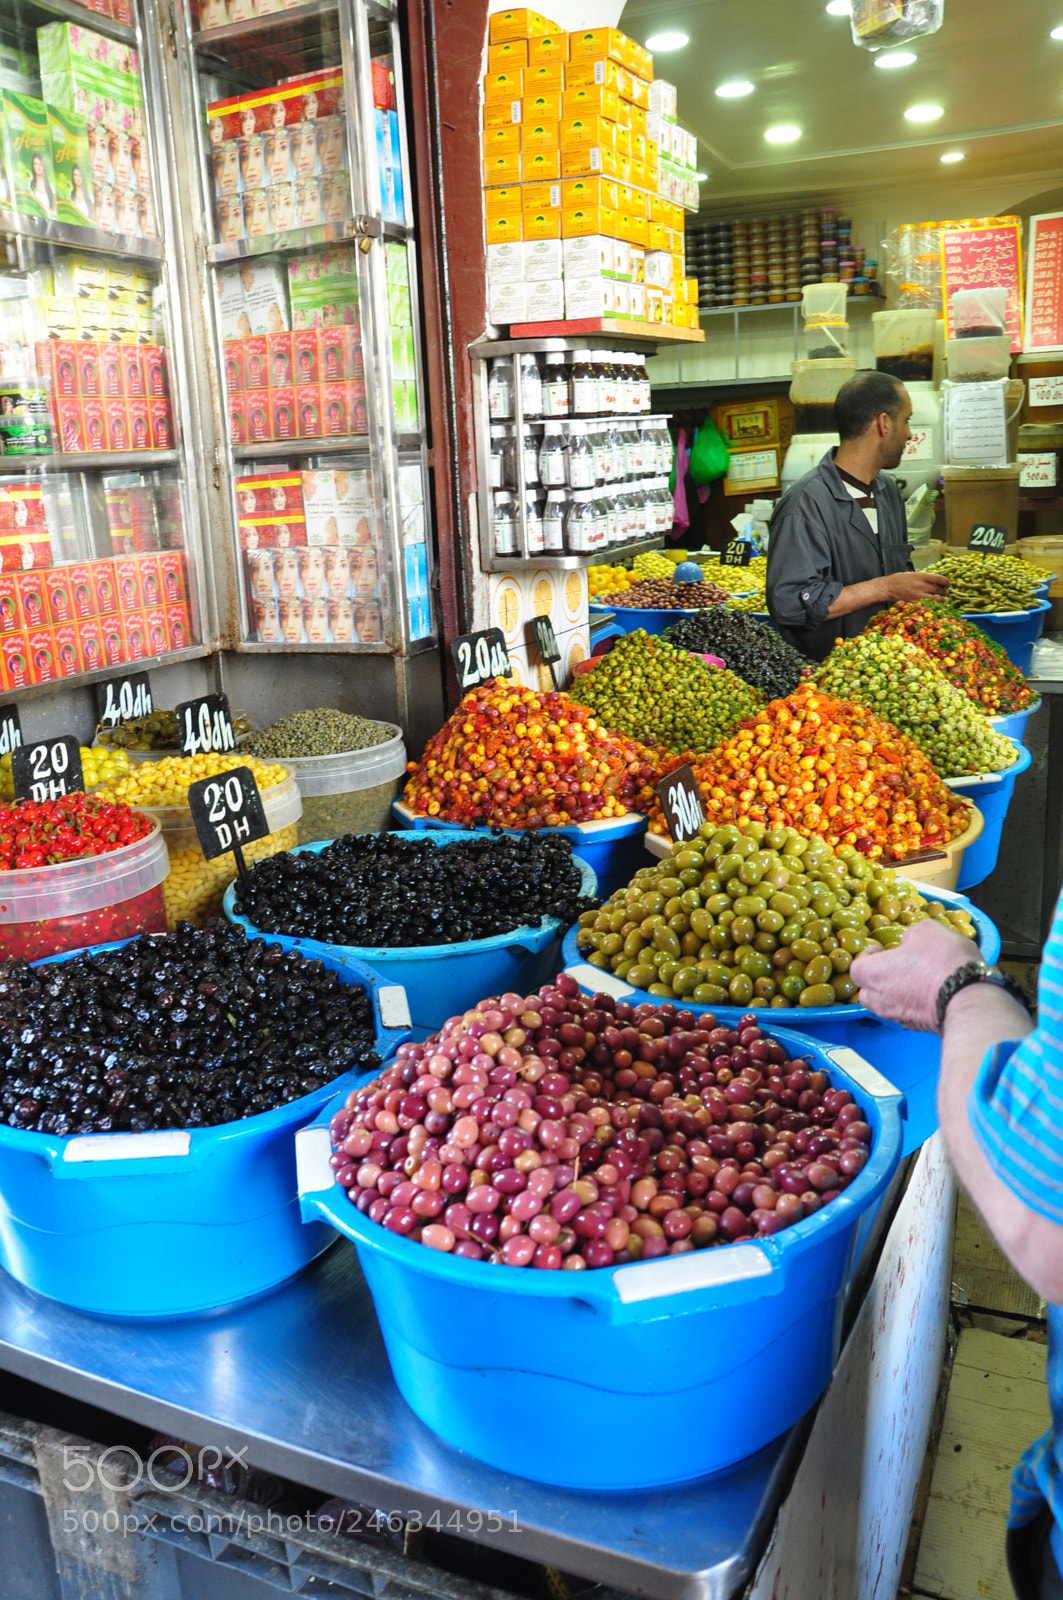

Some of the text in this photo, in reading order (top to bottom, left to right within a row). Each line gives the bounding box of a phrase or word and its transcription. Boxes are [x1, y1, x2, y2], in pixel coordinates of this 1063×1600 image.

[726, 541, 745, 555] 20
[970, 526, 1005, 548] 20dh
[725, 555, 743, 565] DH
[458, 636, 512, 688] 20dh
[102, 680, 152, 727] 40dh
[183, 702, 235, 757] 40dh
[28, 742, 69, 780] 20
[30, 778, 67, 803] DH
[203, 776, 243, 823] 20
[214, 815, 250, 850] DH
